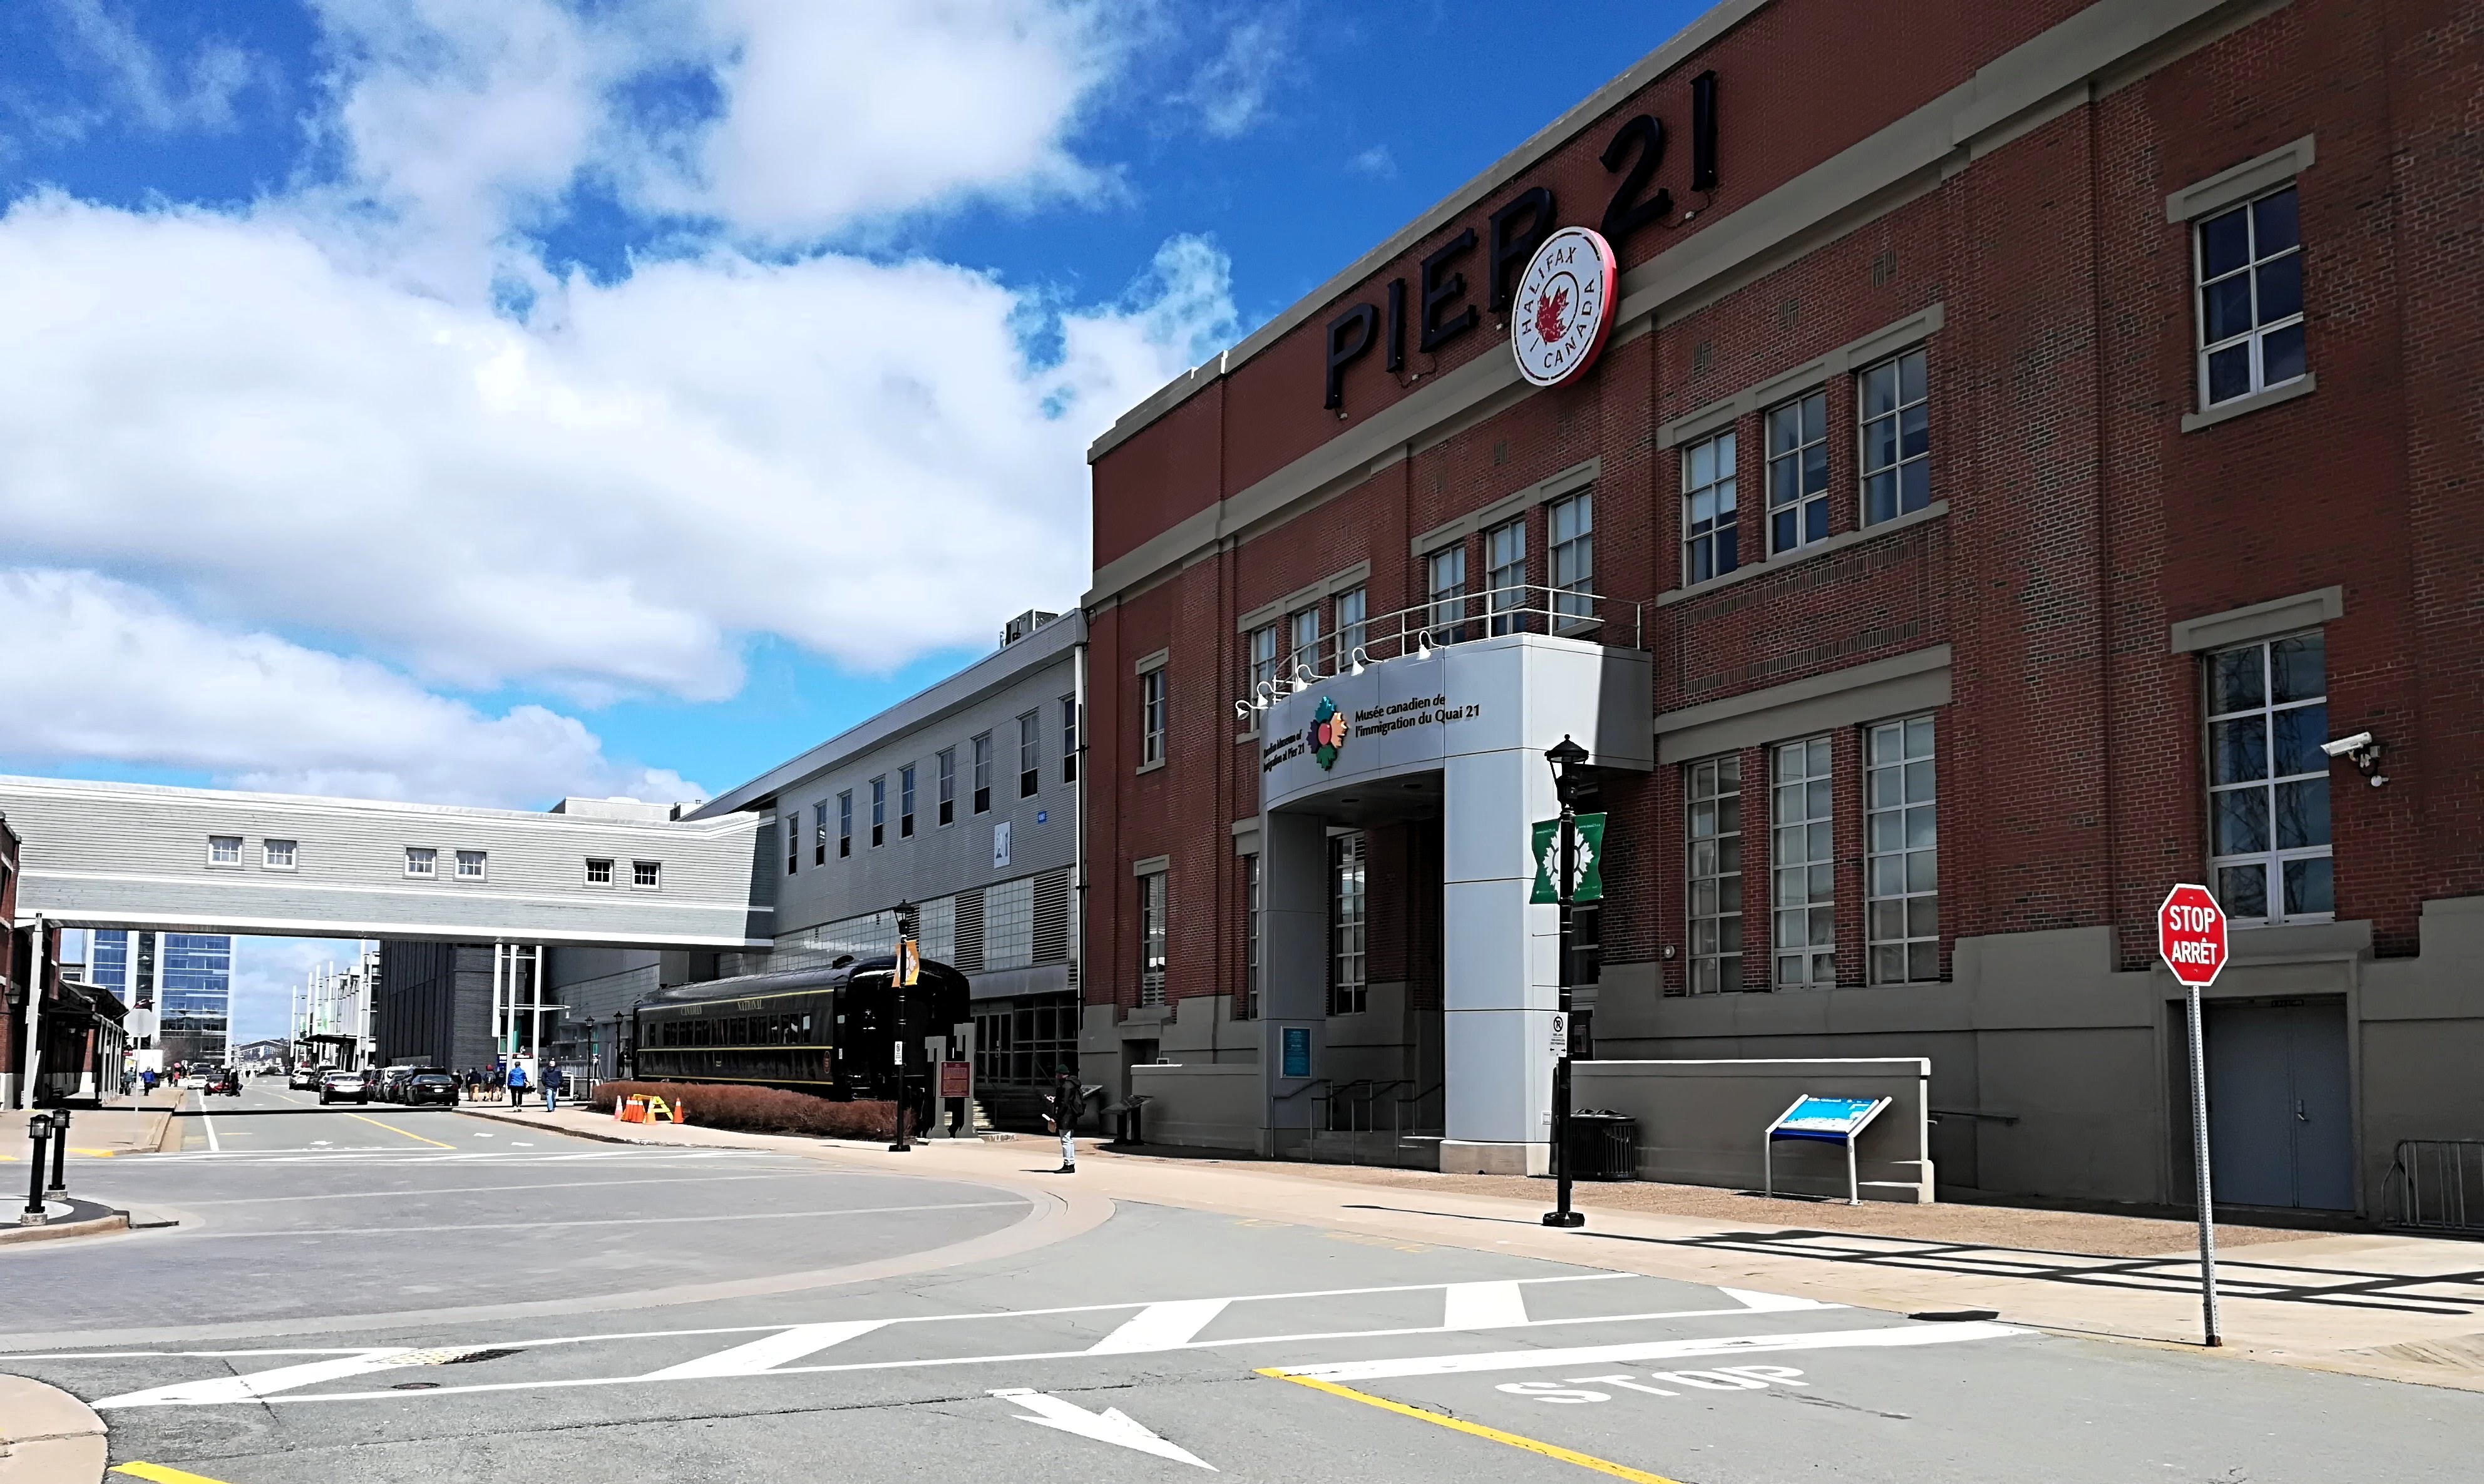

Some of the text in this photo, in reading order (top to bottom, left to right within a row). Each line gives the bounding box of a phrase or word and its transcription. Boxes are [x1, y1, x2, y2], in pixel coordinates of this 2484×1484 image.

[1324, 70, 1717, 410] PIER 21
[1522, 247, 1577, 335] HALIFAX
[1544, 279, 1595, 369] CANADA
[1355, 693, 1445, 722] Musée canadien de
[1355, 704, 1479, 738] l'immigration du Quai 21
[2169, 904, 2216, 933] STOP
[2171, 937, 2217, 965] ARRÊT
[1494, 1365, 1810, 1404] STOP
